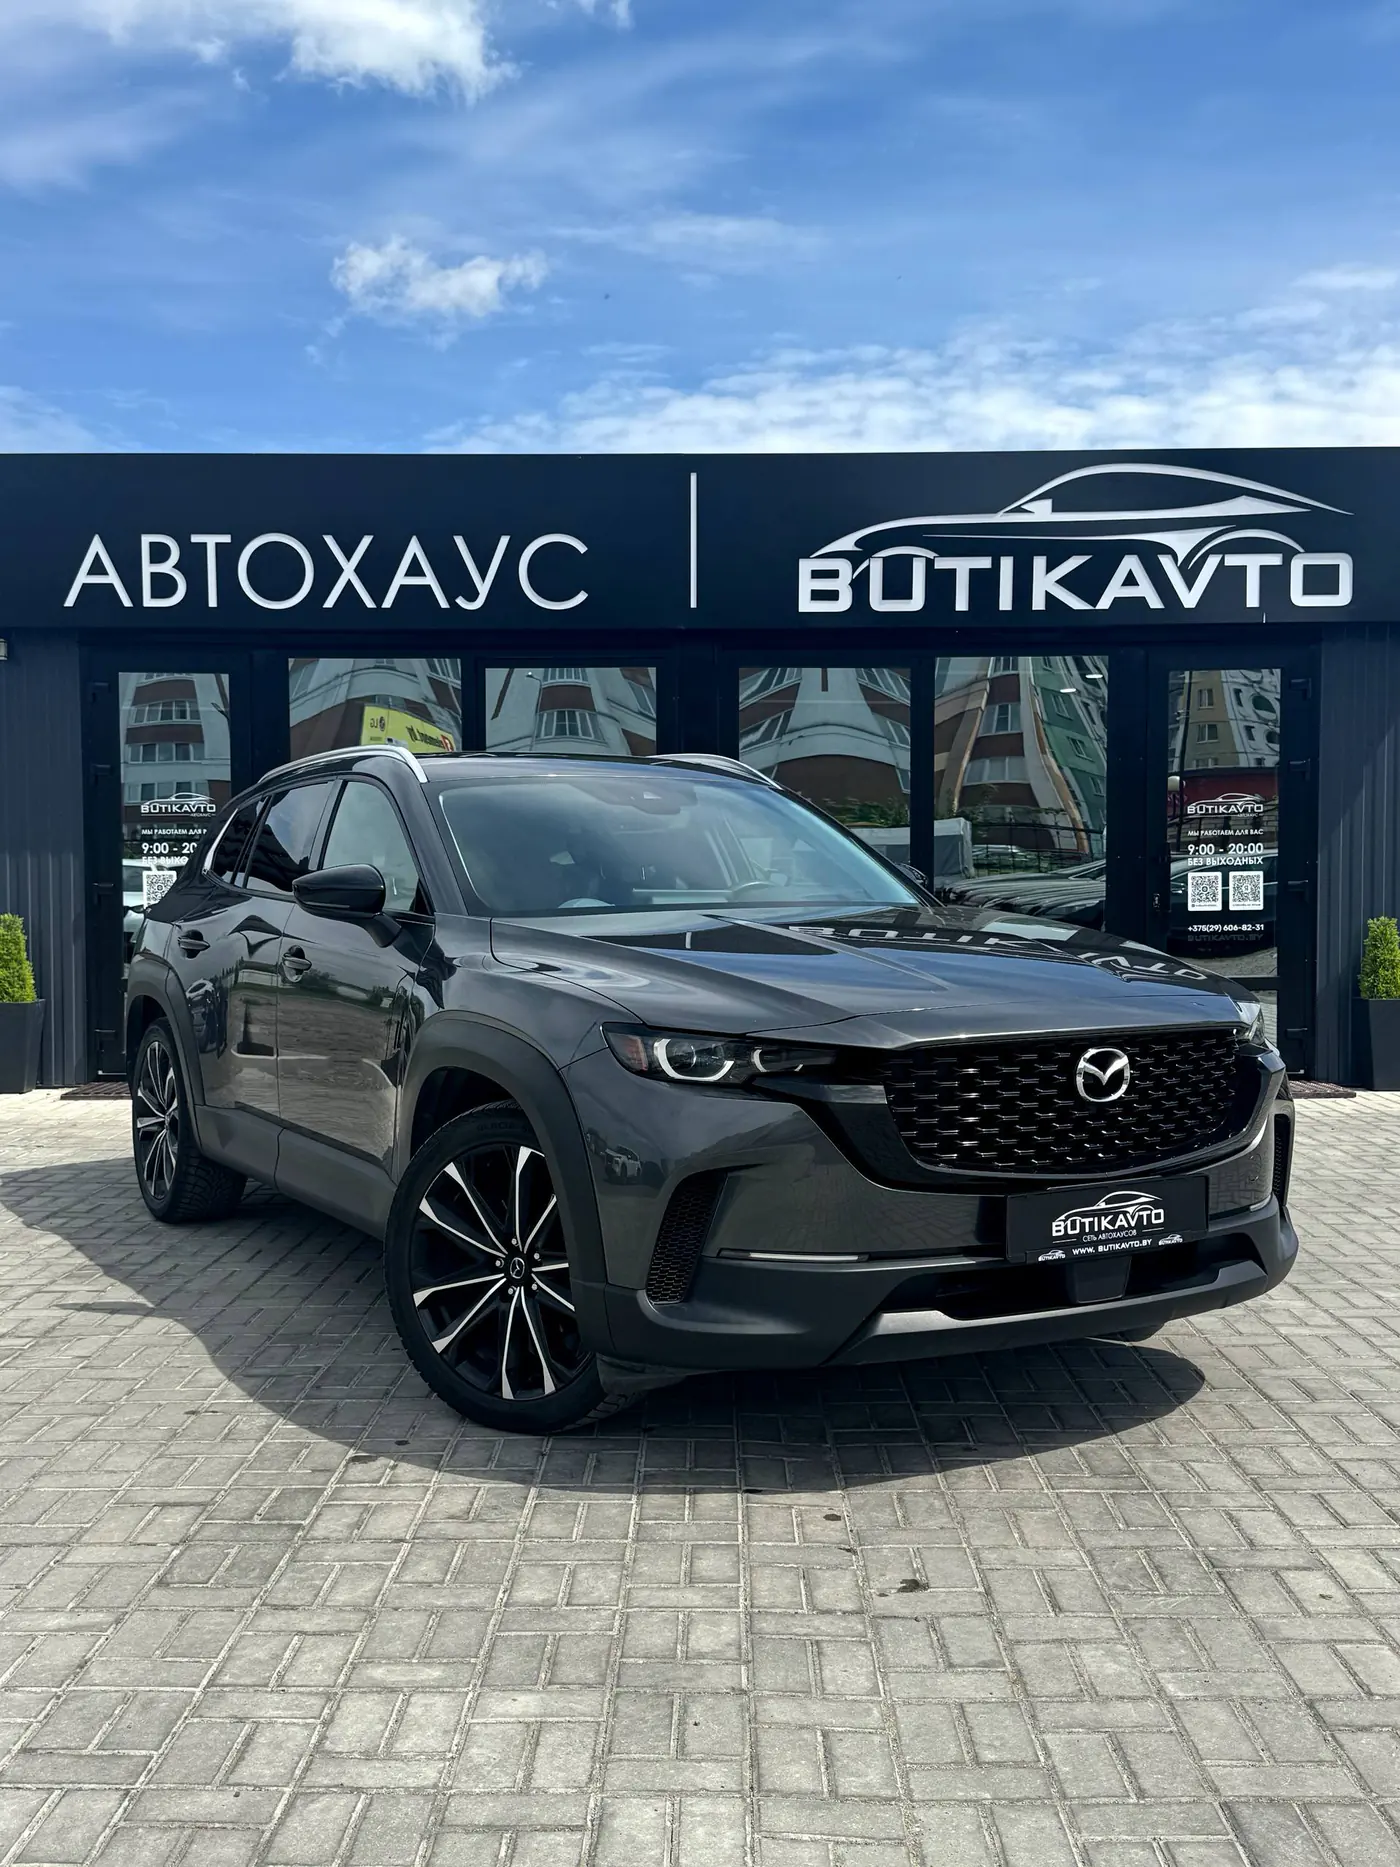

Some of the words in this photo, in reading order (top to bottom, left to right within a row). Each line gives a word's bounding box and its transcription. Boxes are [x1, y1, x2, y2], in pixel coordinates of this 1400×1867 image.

[63, 532, 590, 610] АВТОХАУС
[798, 551, 1354, 613] BUTIKAVTO
[140, 803, 217, 814] BUTIKAVTO
[1186, 803, 1264, 815] BUTIKAVTO
[141, 828, 153, 836] МЫ
[154, 828, 188, 836] РАБОТАЕМ
[188, 828, 202, 836] ДЛЯ
[1200, 829, 1235, 837] РАБОТАЕМ
[1249, 828, 1264, 836] ВАС
[141, 842, 170, 855] 9:00
[1187, 843, 1215, 856] 9:00
[1227, 842, 1264, 855] 20:00
[160, 855, 189, 866] ВЫХО
[1187, 857, 1204, 867] БЕЗ
[1205, 856, 1264, 867] ВЫХОДНЫХ
[1187, 924, 1222, 932] +375(29)
[1222, 923, 1265, 932] 606-82-31
[1052, 1208, 1165, 1237] BUTIKAVTO
[1082, 1234, 1097, 1243] СЕТЬ
[1097, 1229, 1137, 1241] АВТОХАУСОВ
[1072, 1247, 1096, 1256] WWW.
[1098, 1239, 1153, 1253] BUTIKAVTO.BY
